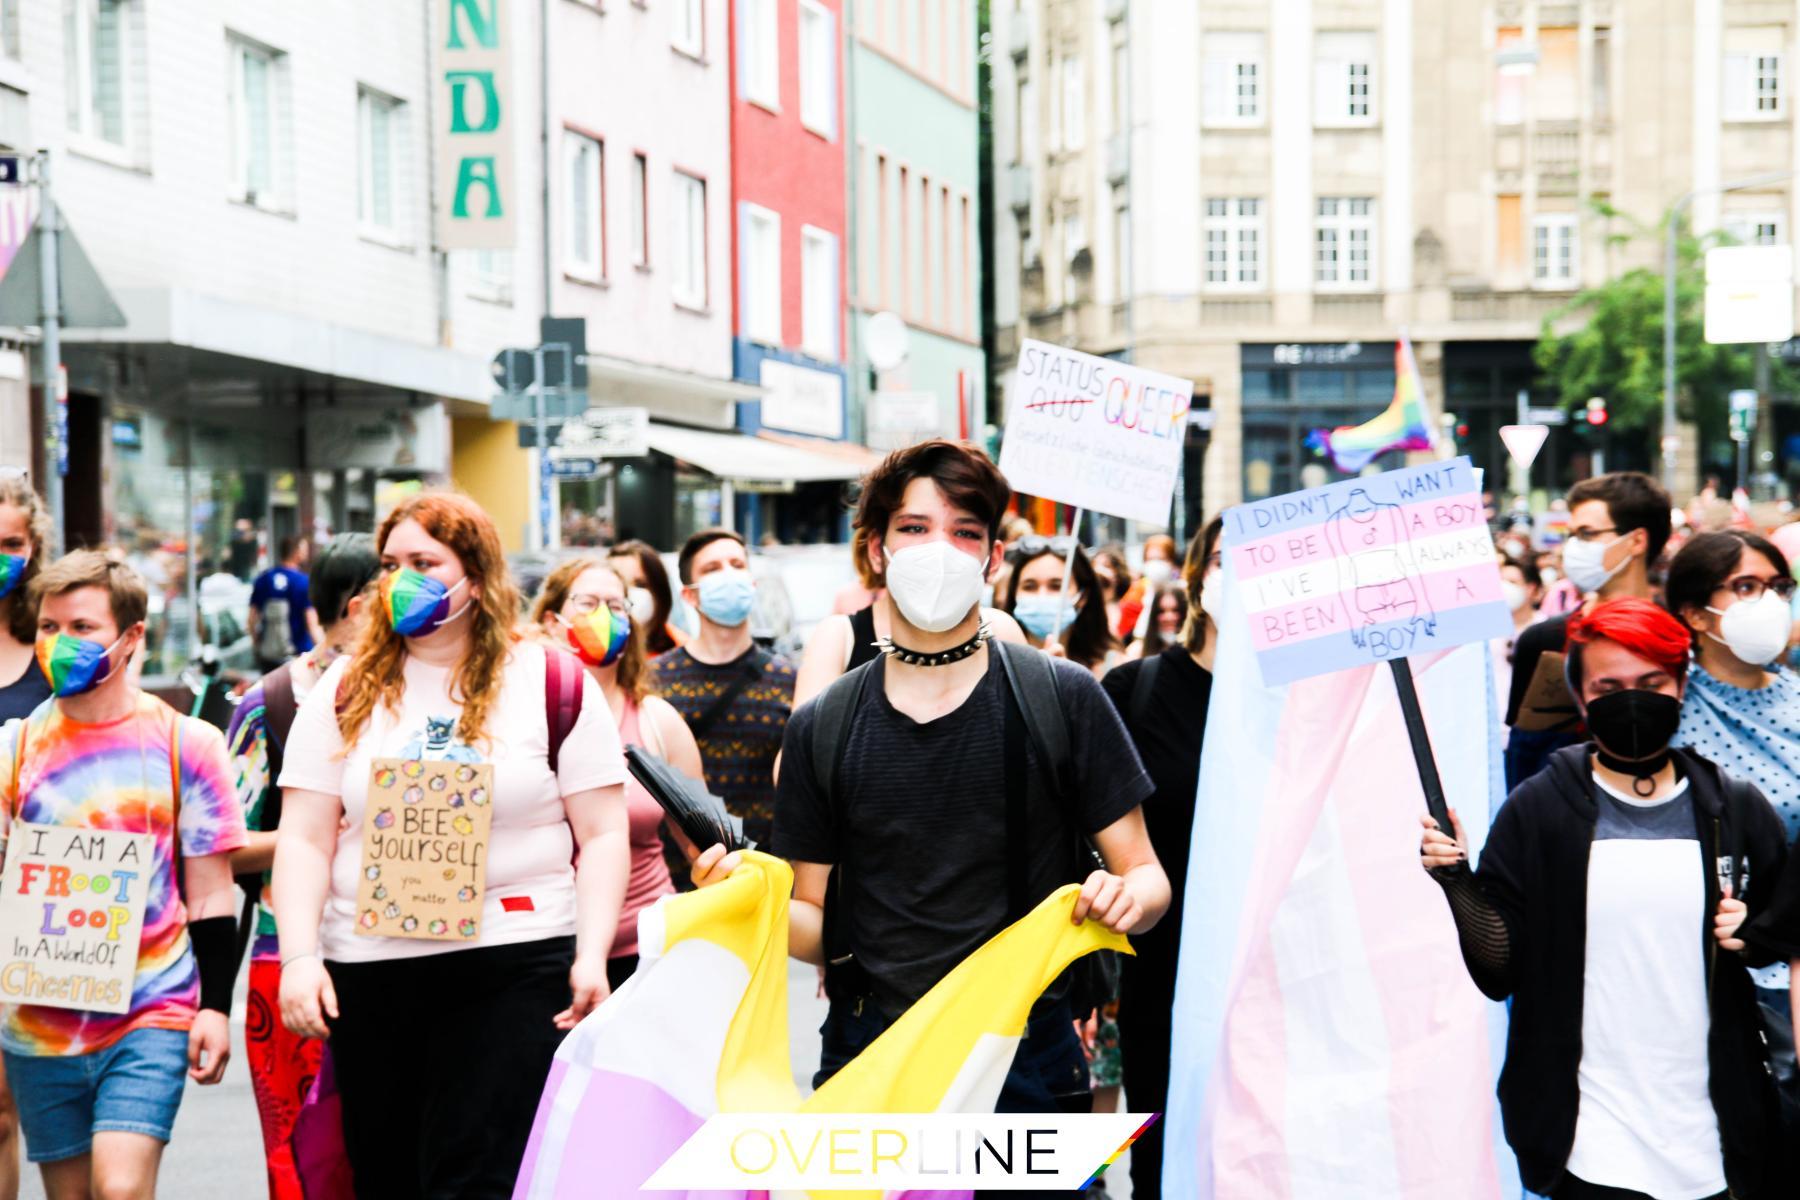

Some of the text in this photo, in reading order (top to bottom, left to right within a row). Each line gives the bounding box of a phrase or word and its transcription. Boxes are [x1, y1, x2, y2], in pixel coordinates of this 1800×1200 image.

[1022, 348, 1104, 397] STATUS
[1030, 386, 1086, 422] QUO
[1104, 377, 1189, 440] QUEER
[1236, 468, 1456, 534] I DIDN'T WANT
[1245, 503, 1478, 567] TO BE A BOY
[1257, 537, 1489, 605] I'VE ALWAYS
[1263, 578, 1474, 642] BEEN A
[1369, 626, 1418, 658] BOY
[403, 807, 450, 836] BEE
[29, 830, 139, 863] I AM A
[369, 834, 484, 882] yourself
[400, 876, 422, 890] you
[412, 893, 446, 905] matter
